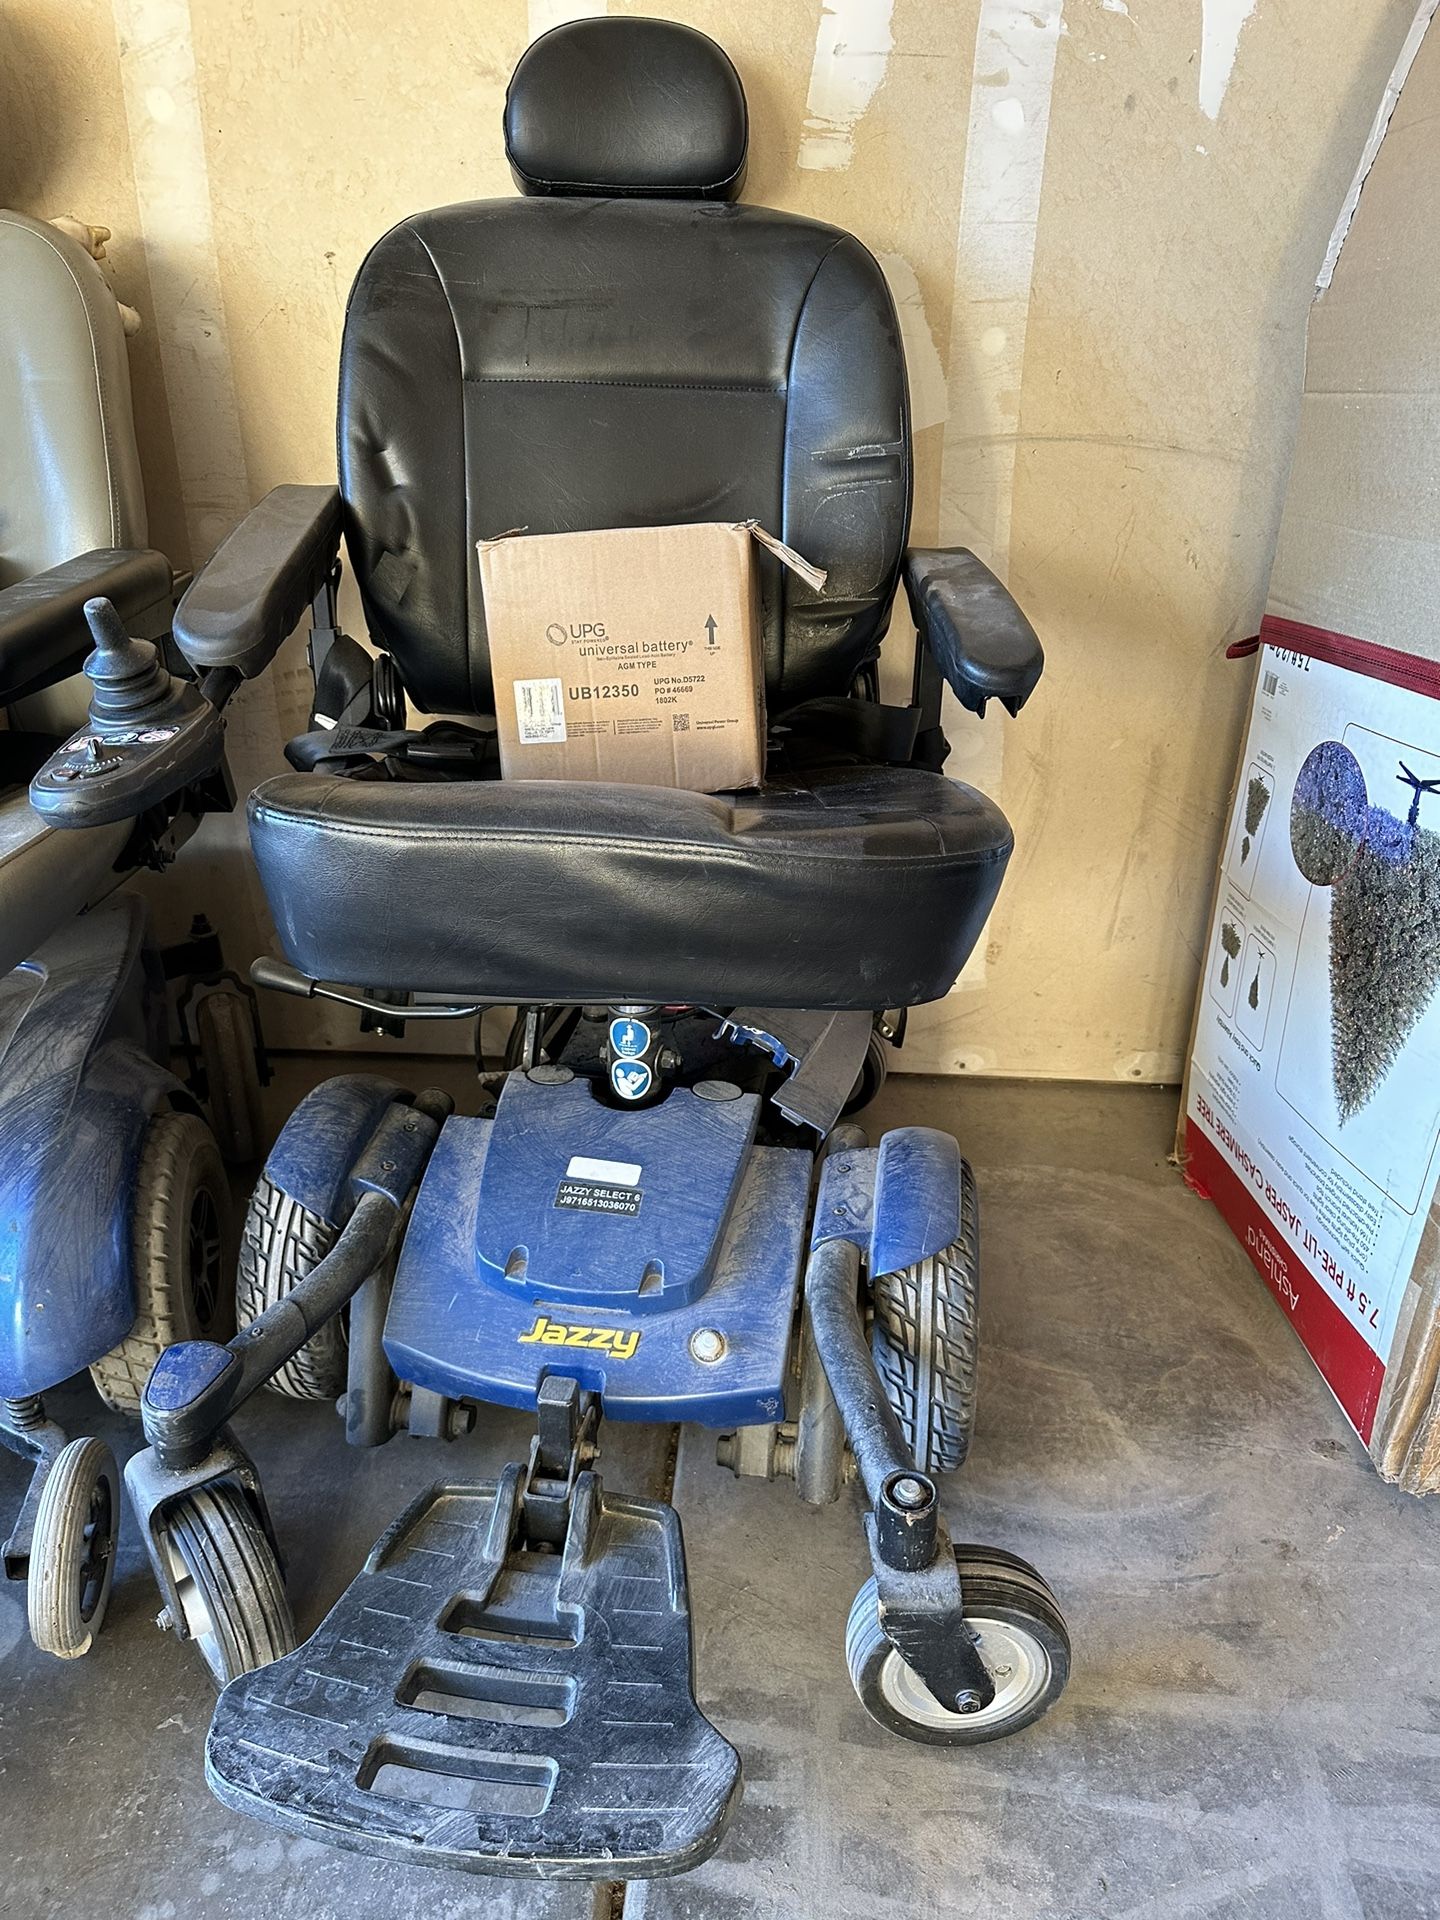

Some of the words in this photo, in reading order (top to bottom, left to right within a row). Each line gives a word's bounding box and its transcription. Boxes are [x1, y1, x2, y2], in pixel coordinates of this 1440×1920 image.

[570, 623, 605, 638] UPG
[579, 642, 639, 656] universal
[618, 662, 635, 670] AGM
[636, 661, 656, 669] TYPE
[654, 677, 670, 685] UPG
[569, 684, 639, 700] UB12350
[1196, 1094, 1215, 1128] TREE
[1215, 1117, 1264, 1190] CASHMERE
[560, 1186, 592, 1196] JAZZY
[594, 1189, 632, 1200] SELECT
[560, 1196, 636, 1211] J9716513036070
[1264, 1179, 1302, 1237] JASPER
[1303, 1228, 1344, 1290] PRE-LIT
[1346, 1278, 1356, 1302] ft
[1358, 1292, 1379, 1329] 7.5
[518, 1317, 641, 1360] Jazzy
